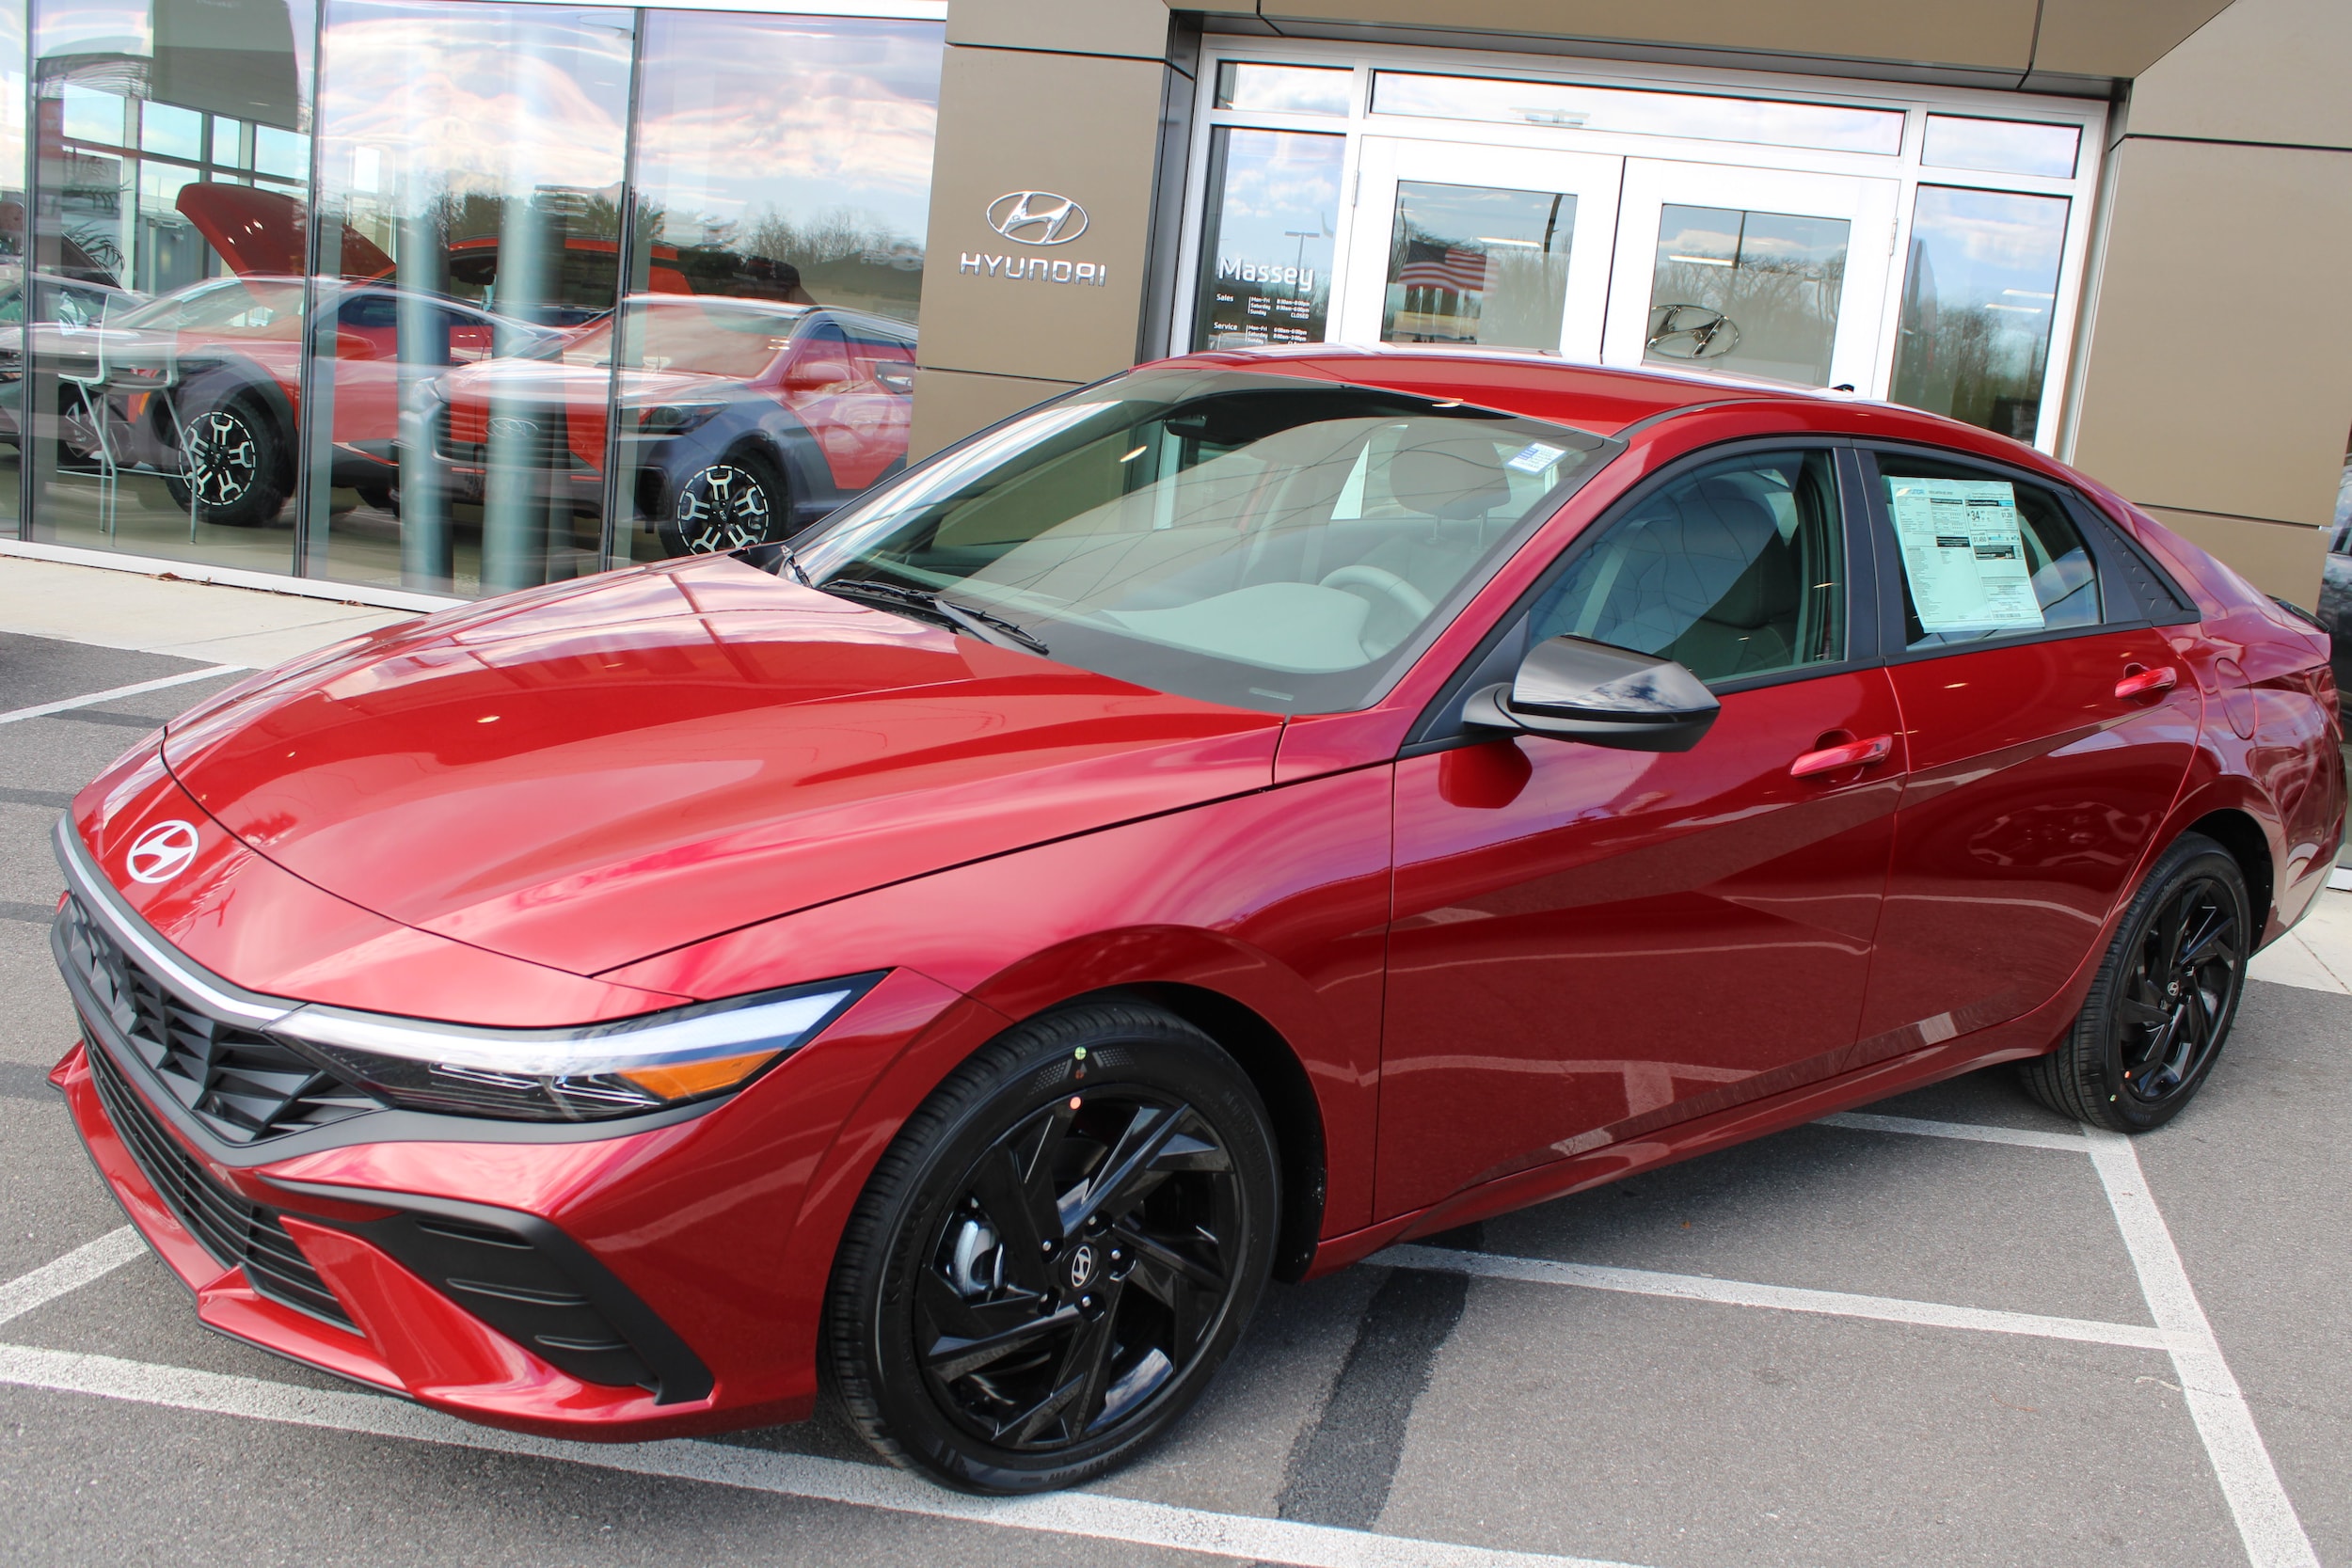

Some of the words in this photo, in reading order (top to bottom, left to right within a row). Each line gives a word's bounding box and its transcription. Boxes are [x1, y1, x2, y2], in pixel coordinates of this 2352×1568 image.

[960, 251, 1106, 287] HYUNDAI
[1218, 256, 1314, 292] Massey
[1216, 293, 1234, 302] Sales
[1214, 322, 1238, 330] Service
[1248, 331, 1268, 340] Saturday
[1971, 510, 1980, 521] 34
